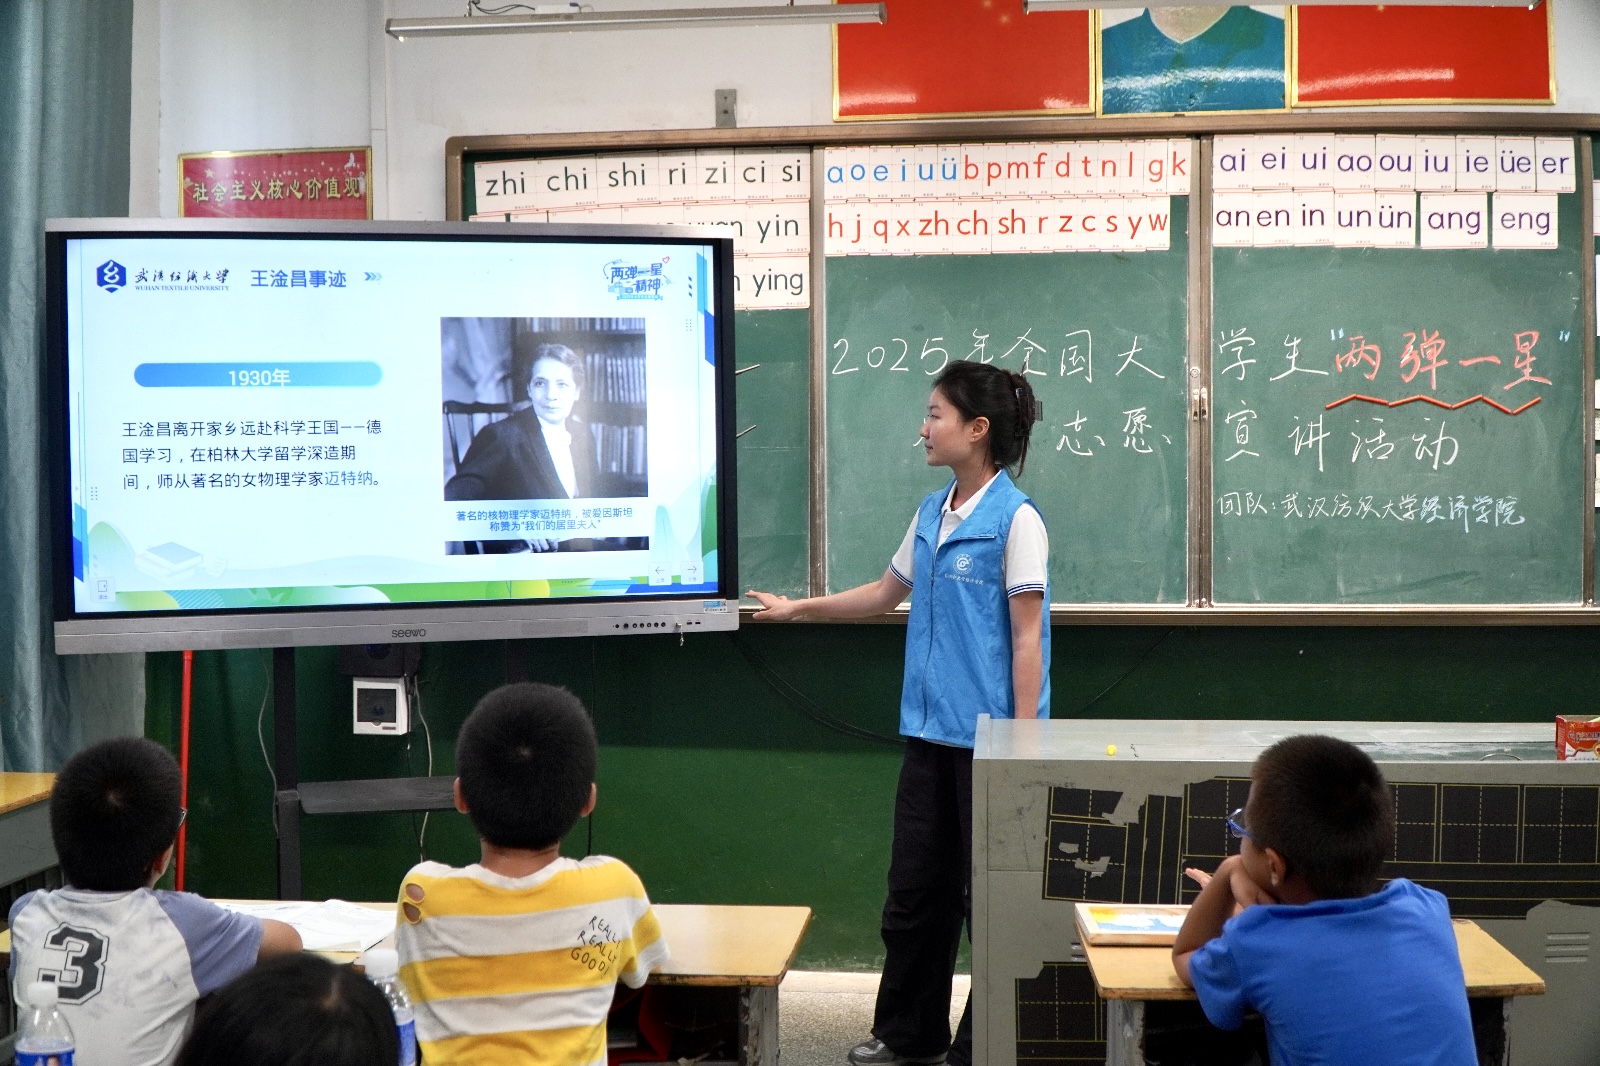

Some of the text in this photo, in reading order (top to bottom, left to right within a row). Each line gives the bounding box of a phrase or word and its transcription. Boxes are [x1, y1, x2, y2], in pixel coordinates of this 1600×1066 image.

[827, 150, 1186, 187] a o e i u ü b p m f d t n l g k
[1219, 146, 1570, 175] ai ei ui ao ou iu ie üe er
[193, 177, 360, 203] 社会主义核心价值观
[485, 159, 801, 197] zhi chi shi ri zi ci si
[756, 214, 799, 244] yin
[828, 212, 843, 238] h
[851, 213, 861, 244] j
[873, 219, 888, 244] q
[896, 219, 911, 237] x
[918, 209, 949, 237] zh
[956, 209, 988, 236] ch
[998, 208, 1026, 235] sh
[1038, 216, 1049, 234] r
[1058, 215, 1073, 233] z
[1081, 215, 1096, 233] c
[1106, 215, 1118, 233] s
[1127, 216, 1143, 240] y
[1215, 203, 1550, 236] an en in un ün ang eng
[250, 269, 347, 288] 王淦昌事迹
[610, 262, 663, 284] 两弹一星
[632, 277, 661, 295] 精神
[752, 268, 803, 298] ying
[228, 368, 291, 388] 1930年
[1224, 400, 1460, 472] 宣讲活动
[121, 445, 356, 464] 国学习，在柏林大学留学深造期
[122, 470, 380, 490] 间，师从著名的女物理学家迈特纳。
[455, 507, 633, 522] 著名的核物理学家迈特纳，被爱因斯坦
[391, 628, 427, 638] seewo
[576, 929, 617, 964] REALLY
[588, 915, 621, 950] REALLY
[37, 921, 110, 1006] 3
